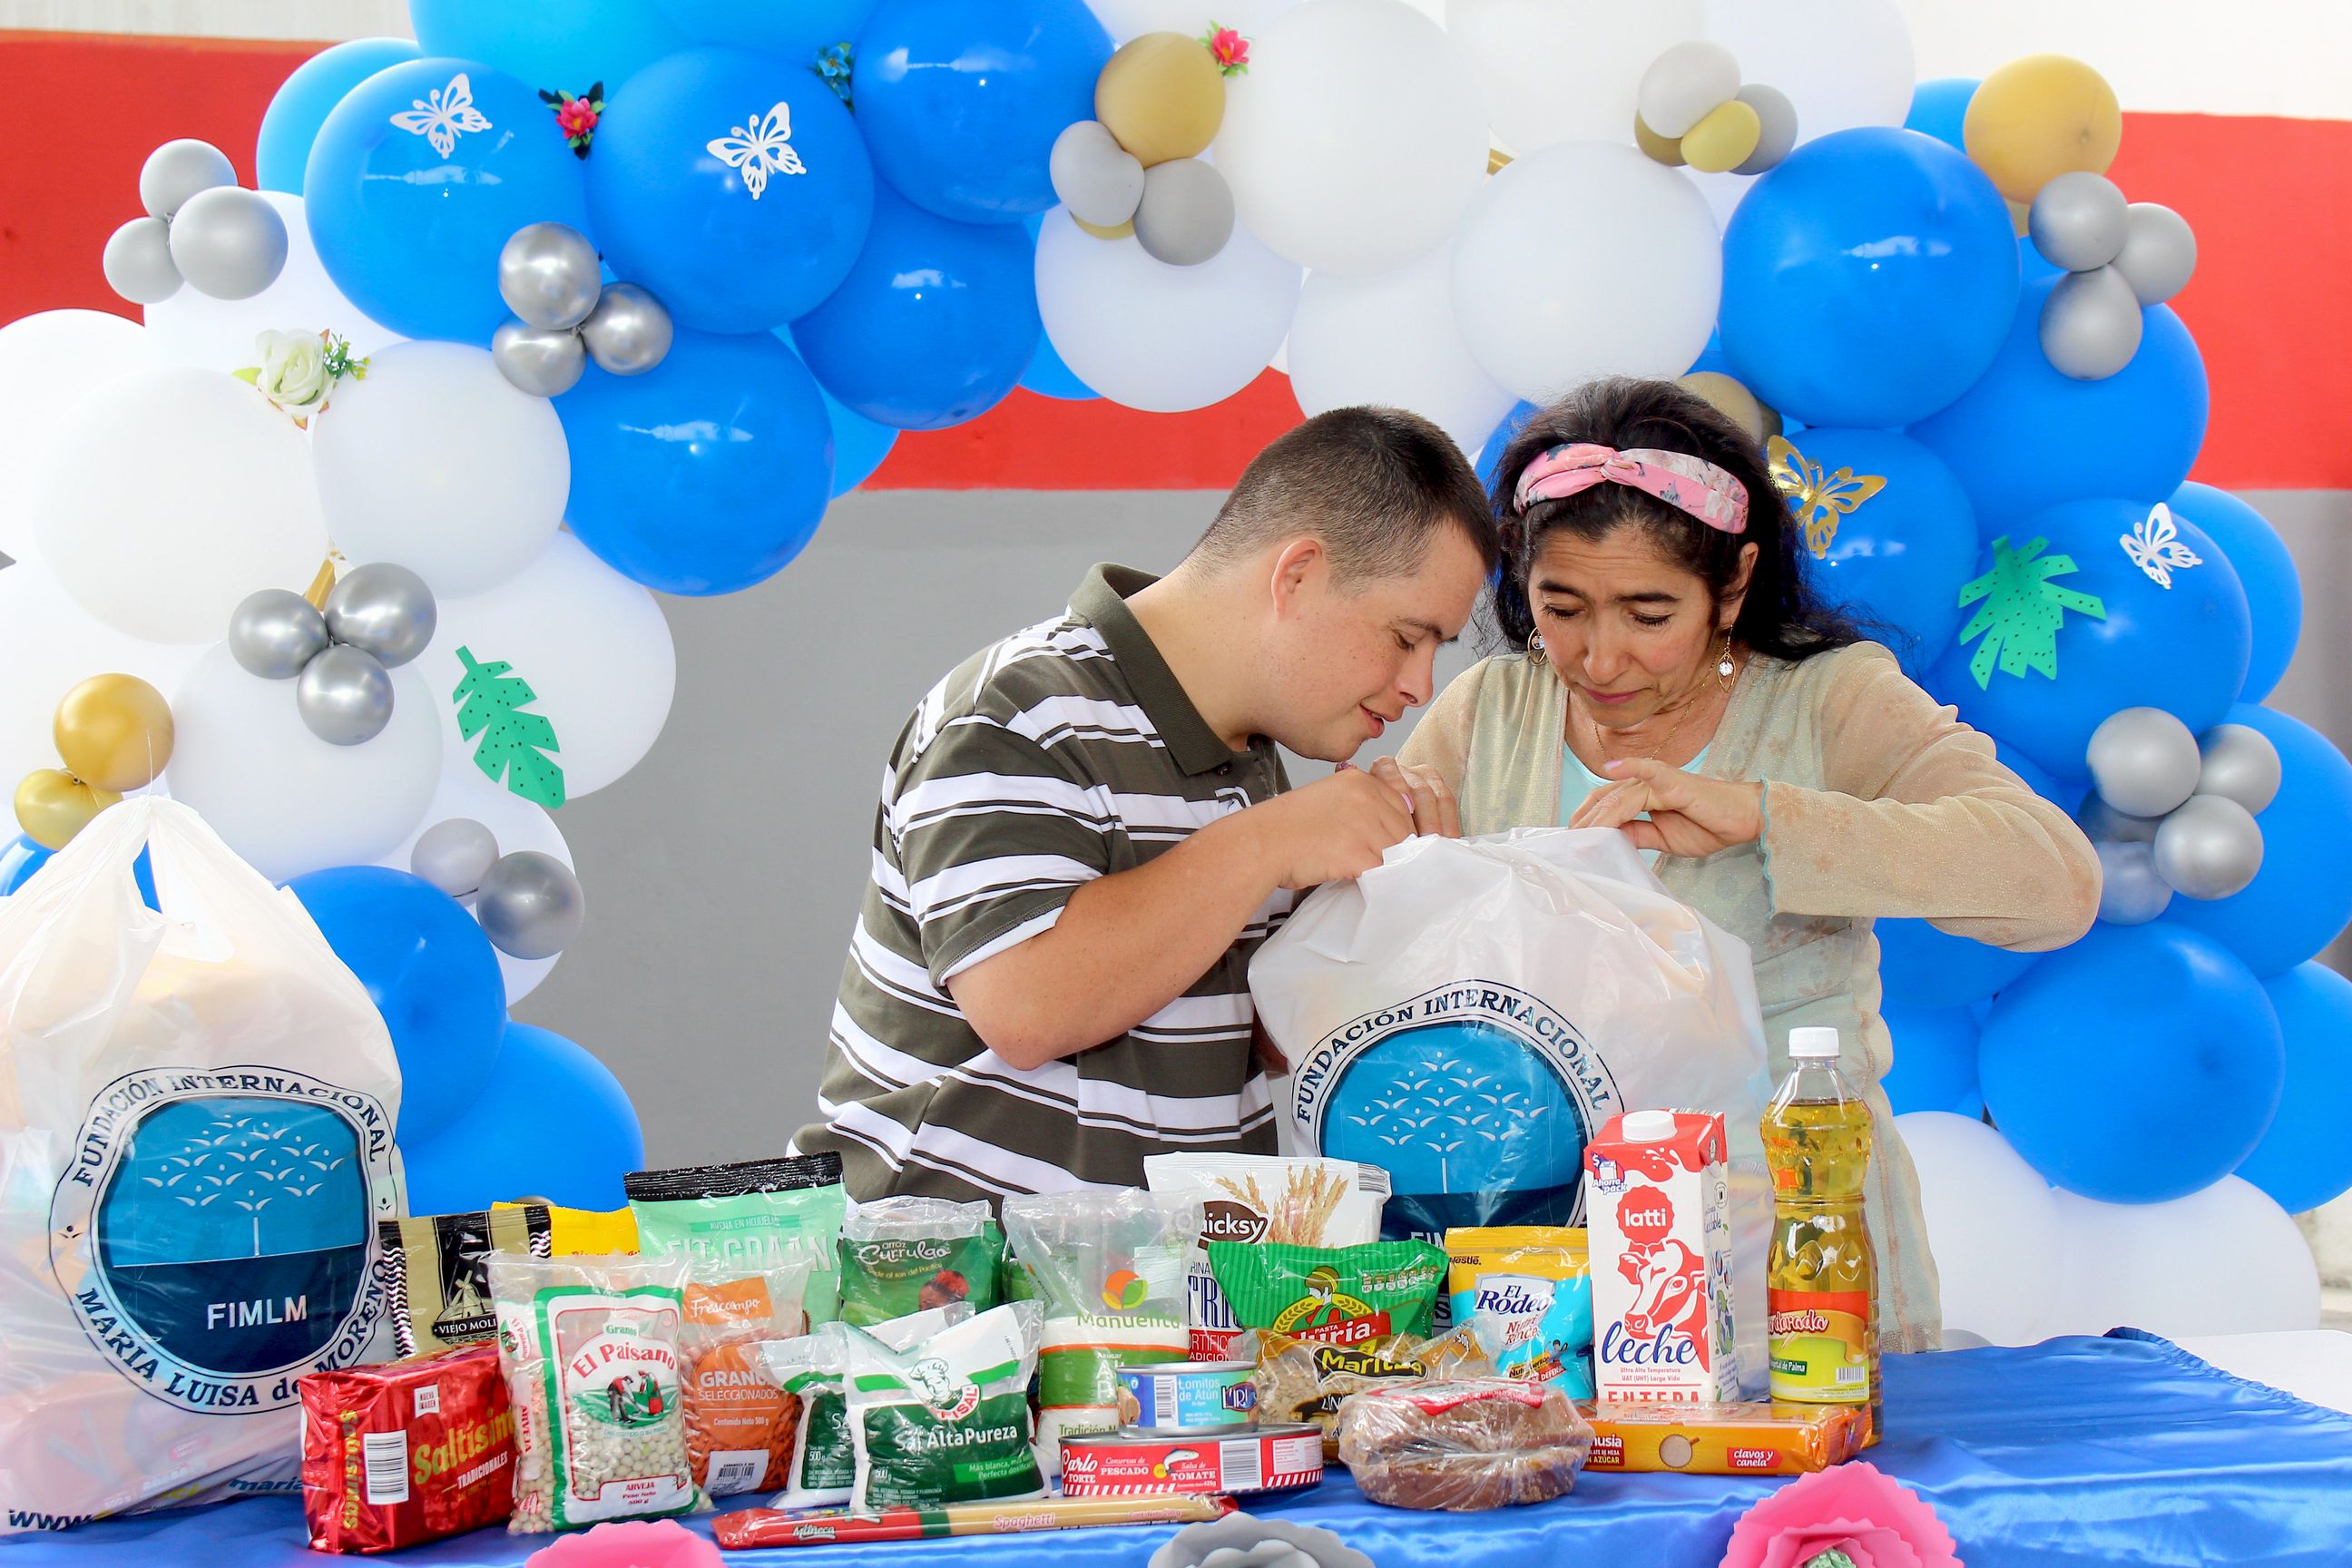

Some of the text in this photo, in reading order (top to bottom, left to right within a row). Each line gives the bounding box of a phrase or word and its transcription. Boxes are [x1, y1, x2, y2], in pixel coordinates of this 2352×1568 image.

[1297, 988, 1610, 1124] FUNDACIÓN INTERNACIONAL
[72, 1073, 388, 1187] FUNDACIÓN INTERNACIONAL
[1592, 1178, 1621, 1187] Ahorra
[1603, 1183, 1628, 1195] pack
[734, 1219, 745, 1227] EN
[1624, 1208, 1667, 1227] latti
[882, 1241, 906, 1250] arroz
[1505, 1285, 1522, 1298] El
[1476, 1290, 1551, 1315] Rodeo
[207, 1295, 308, 1330] FIMLM
[164, 1371, 260, 1407] LUISA
[314, 1259, 387, 1373] MORENO
[438, 1321, 467, 1335] VIEJO
[1314, 1324, 1338, 1334] PASTA
[1602, 1320, 1699, 1365] leche
[573, 1340, 676, 1378] El Paisano
[1788, 1362, 1806, 1372] Palma
[1179, 1378, 1220, 1389] Lomitos
[699, 1388, 779, 1401] SELECCIONADOS
[1180, 1388, 1219, 1401] de Atún
[808, 1450, 821, 1461] 500
[1105, 1455, 1146, 1465] Conservas de
[1593, 1455, 1620, 1464] AZÚCAR
[1733, 1448, 1774, 1461] clavos y
[1062, 1448, 1098, 1478] Carlo
[1199, 1461, 1206, 1469] de
[1736, 1457, 1767, 1466] canela
[457, 1450, 508, 1489] TRADICIONALES
[1101, 1466, 1149, 1475] PESCADO
[1171, 1470, 1216, 1481] TOMATE
[1068, 1474, 1096, 1484] FORTE
[626, 1482, 655, 1491] ARVEJA
[993, 1512, 1056, 1532] Spaghetti
